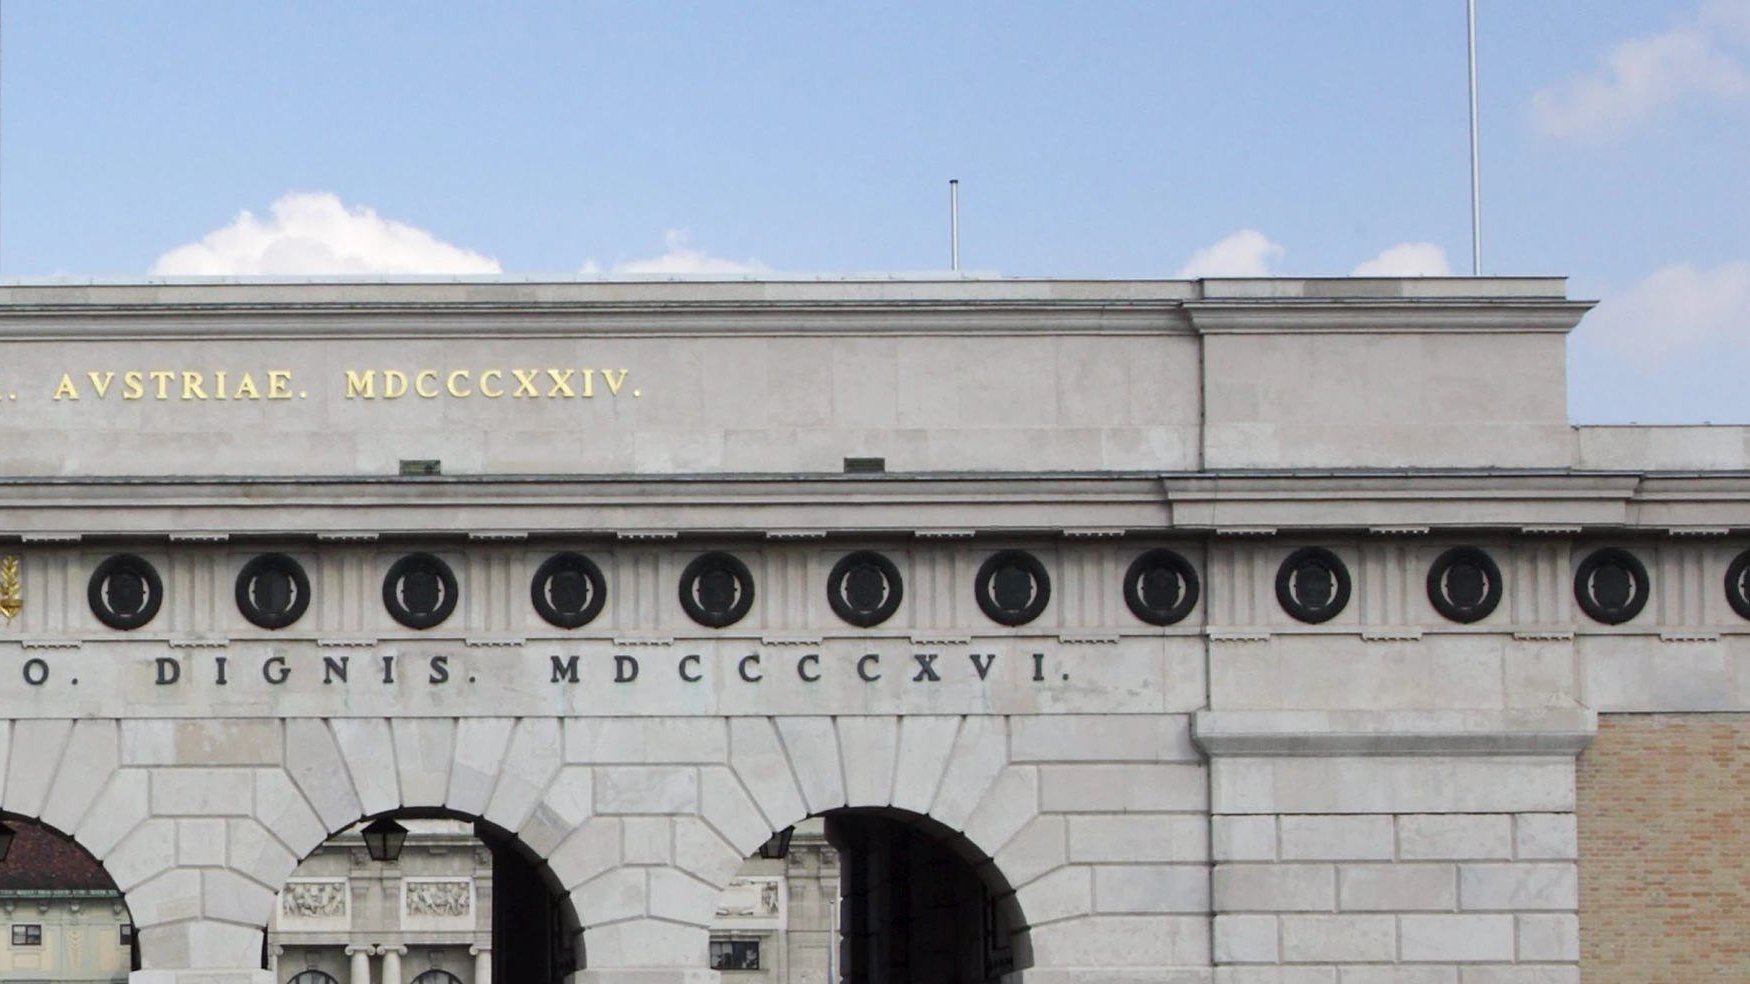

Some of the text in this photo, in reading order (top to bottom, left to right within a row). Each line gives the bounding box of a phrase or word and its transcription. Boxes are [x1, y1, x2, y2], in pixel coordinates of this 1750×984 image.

[53, 369, 308, 401] AVSTRIAE.
[345, 367, 642, 399] MDCCCXXIV.
[154, 655, 477, 686] DIGNIS.
[549, 653, 1070, 684] MDCCCCXVI.
